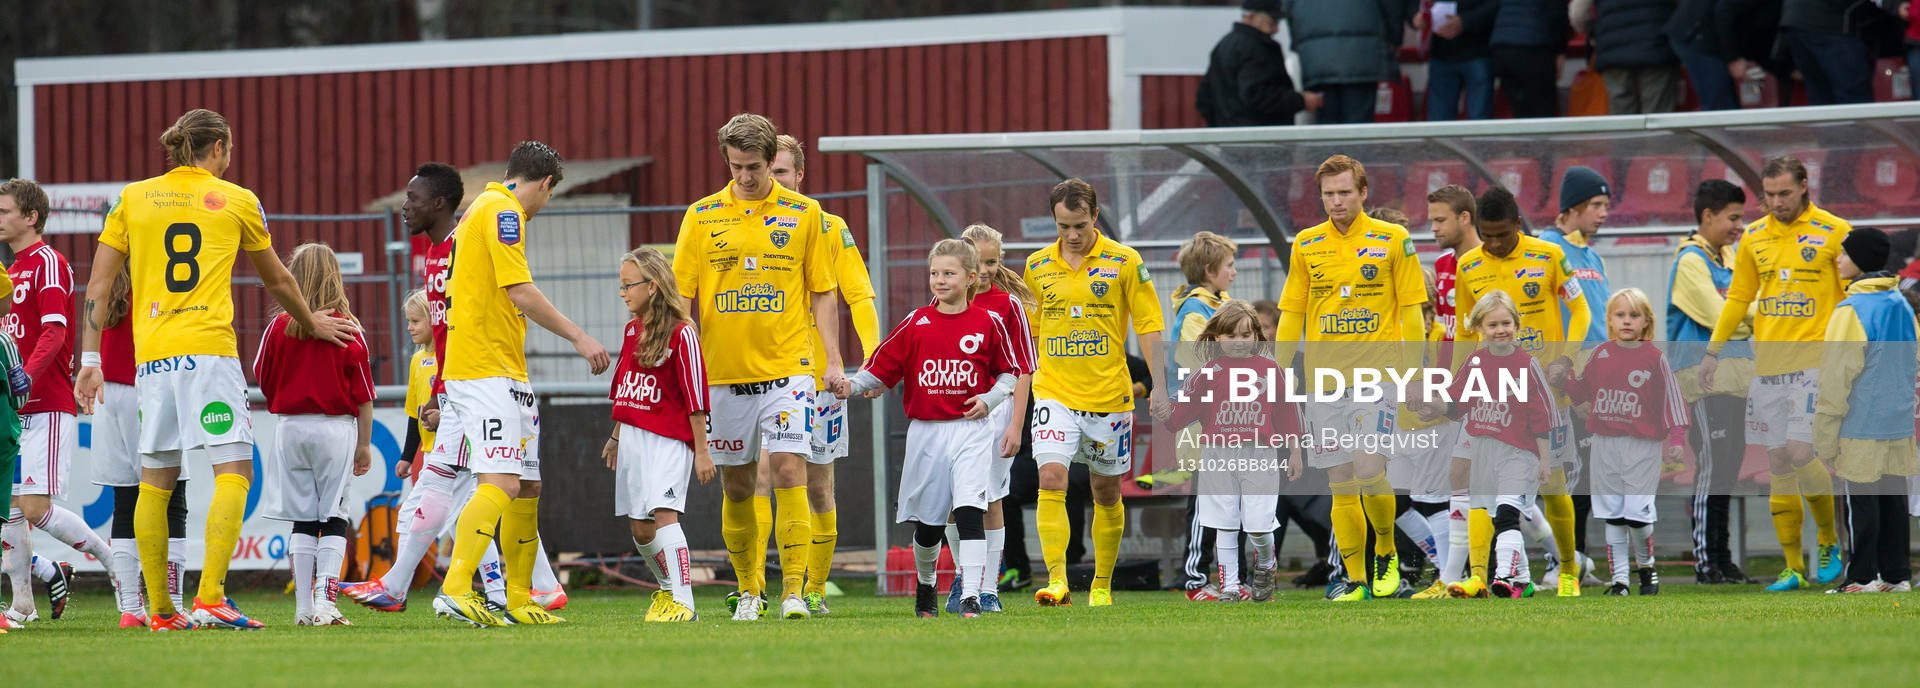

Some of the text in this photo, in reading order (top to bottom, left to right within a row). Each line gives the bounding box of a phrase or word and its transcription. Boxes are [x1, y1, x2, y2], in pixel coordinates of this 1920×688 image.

[164, 222, 202, 293] 8
[741, 283, 776, 298] Gekås
[715, 290, 785, 313] Ullared
[1320, 313, 1380, 334] Ullared
[1070, 330, 1100, 343] Gekås
[1047, 334, 1109, 357] Ullared
[923, 359, 974, 375] OUTO
[918, 372, 979, 388] KUMPU
[1596, 388, 1640, 405] OUTO
[203, 412, 231, 424] dina
[1032, 406, 1051, 428] 20
[1215, 410, 1266, 426] KUMPU
[483, 418, 503, 441] 12
